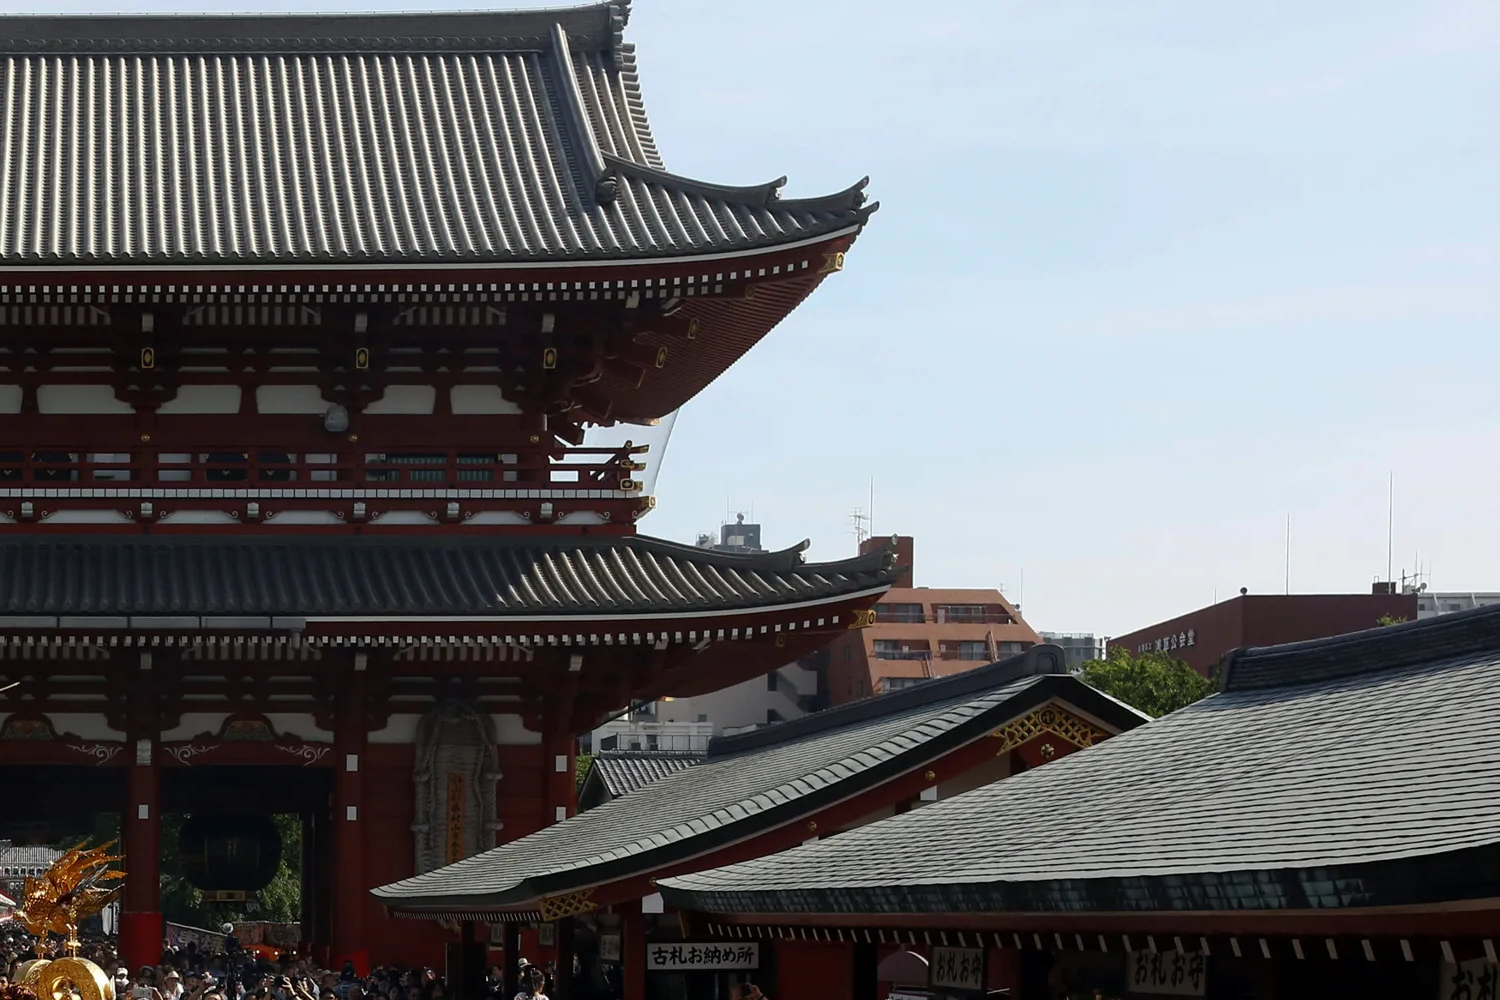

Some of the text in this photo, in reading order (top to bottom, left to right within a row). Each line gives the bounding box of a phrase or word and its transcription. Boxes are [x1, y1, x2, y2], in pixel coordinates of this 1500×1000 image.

[651, 945, 755, 966] 古札お納め所
[936, 951, 982, 986] お札お守
[1134, 949, 1204, 991] お札お守
